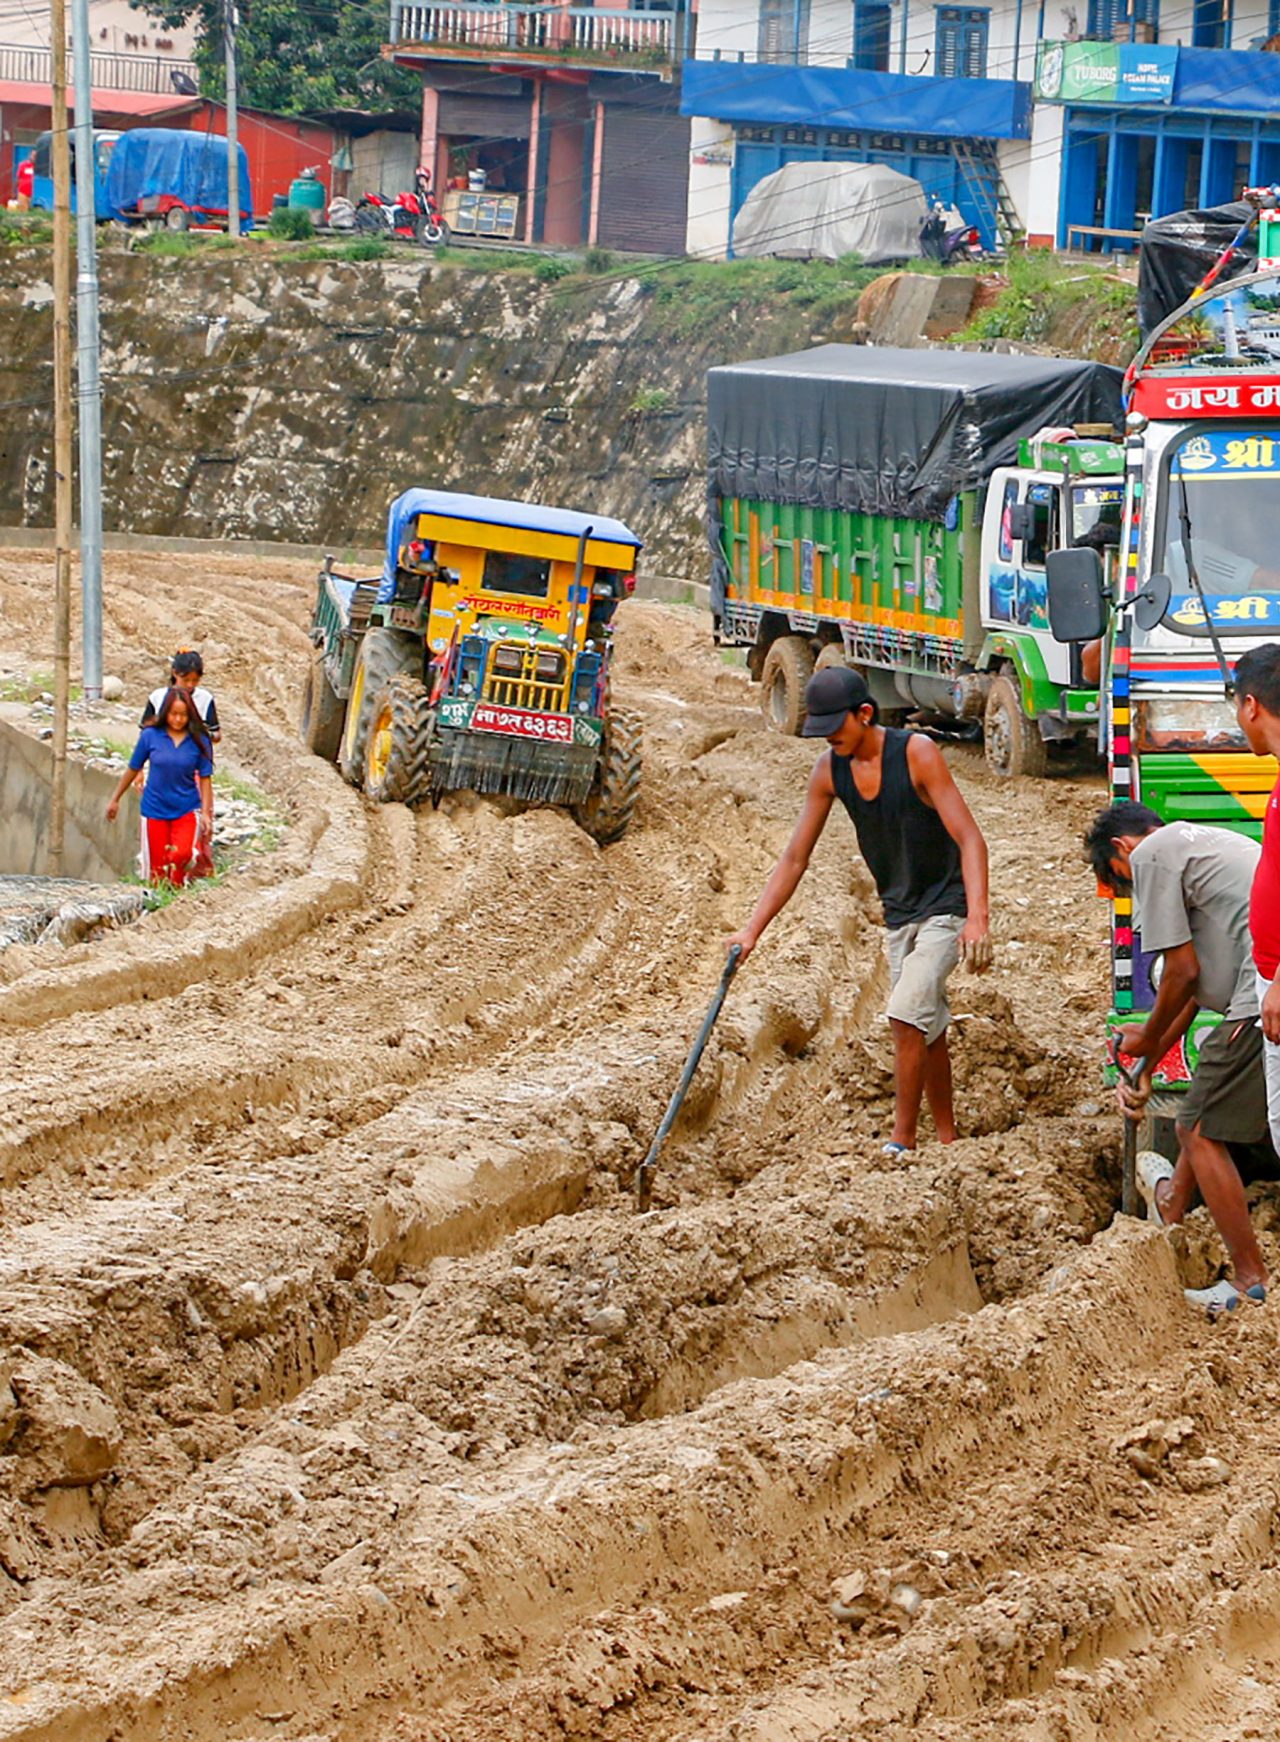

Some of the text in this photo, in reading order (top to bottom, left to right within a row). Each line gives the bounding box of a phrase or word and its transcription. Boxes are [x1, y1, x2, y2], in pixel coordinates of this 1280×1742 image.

[1074, 65, 1117, 82] TUBORG
[1166, 386, 1241, 410] जय
[1212, 596, 1271, 619] श्री
